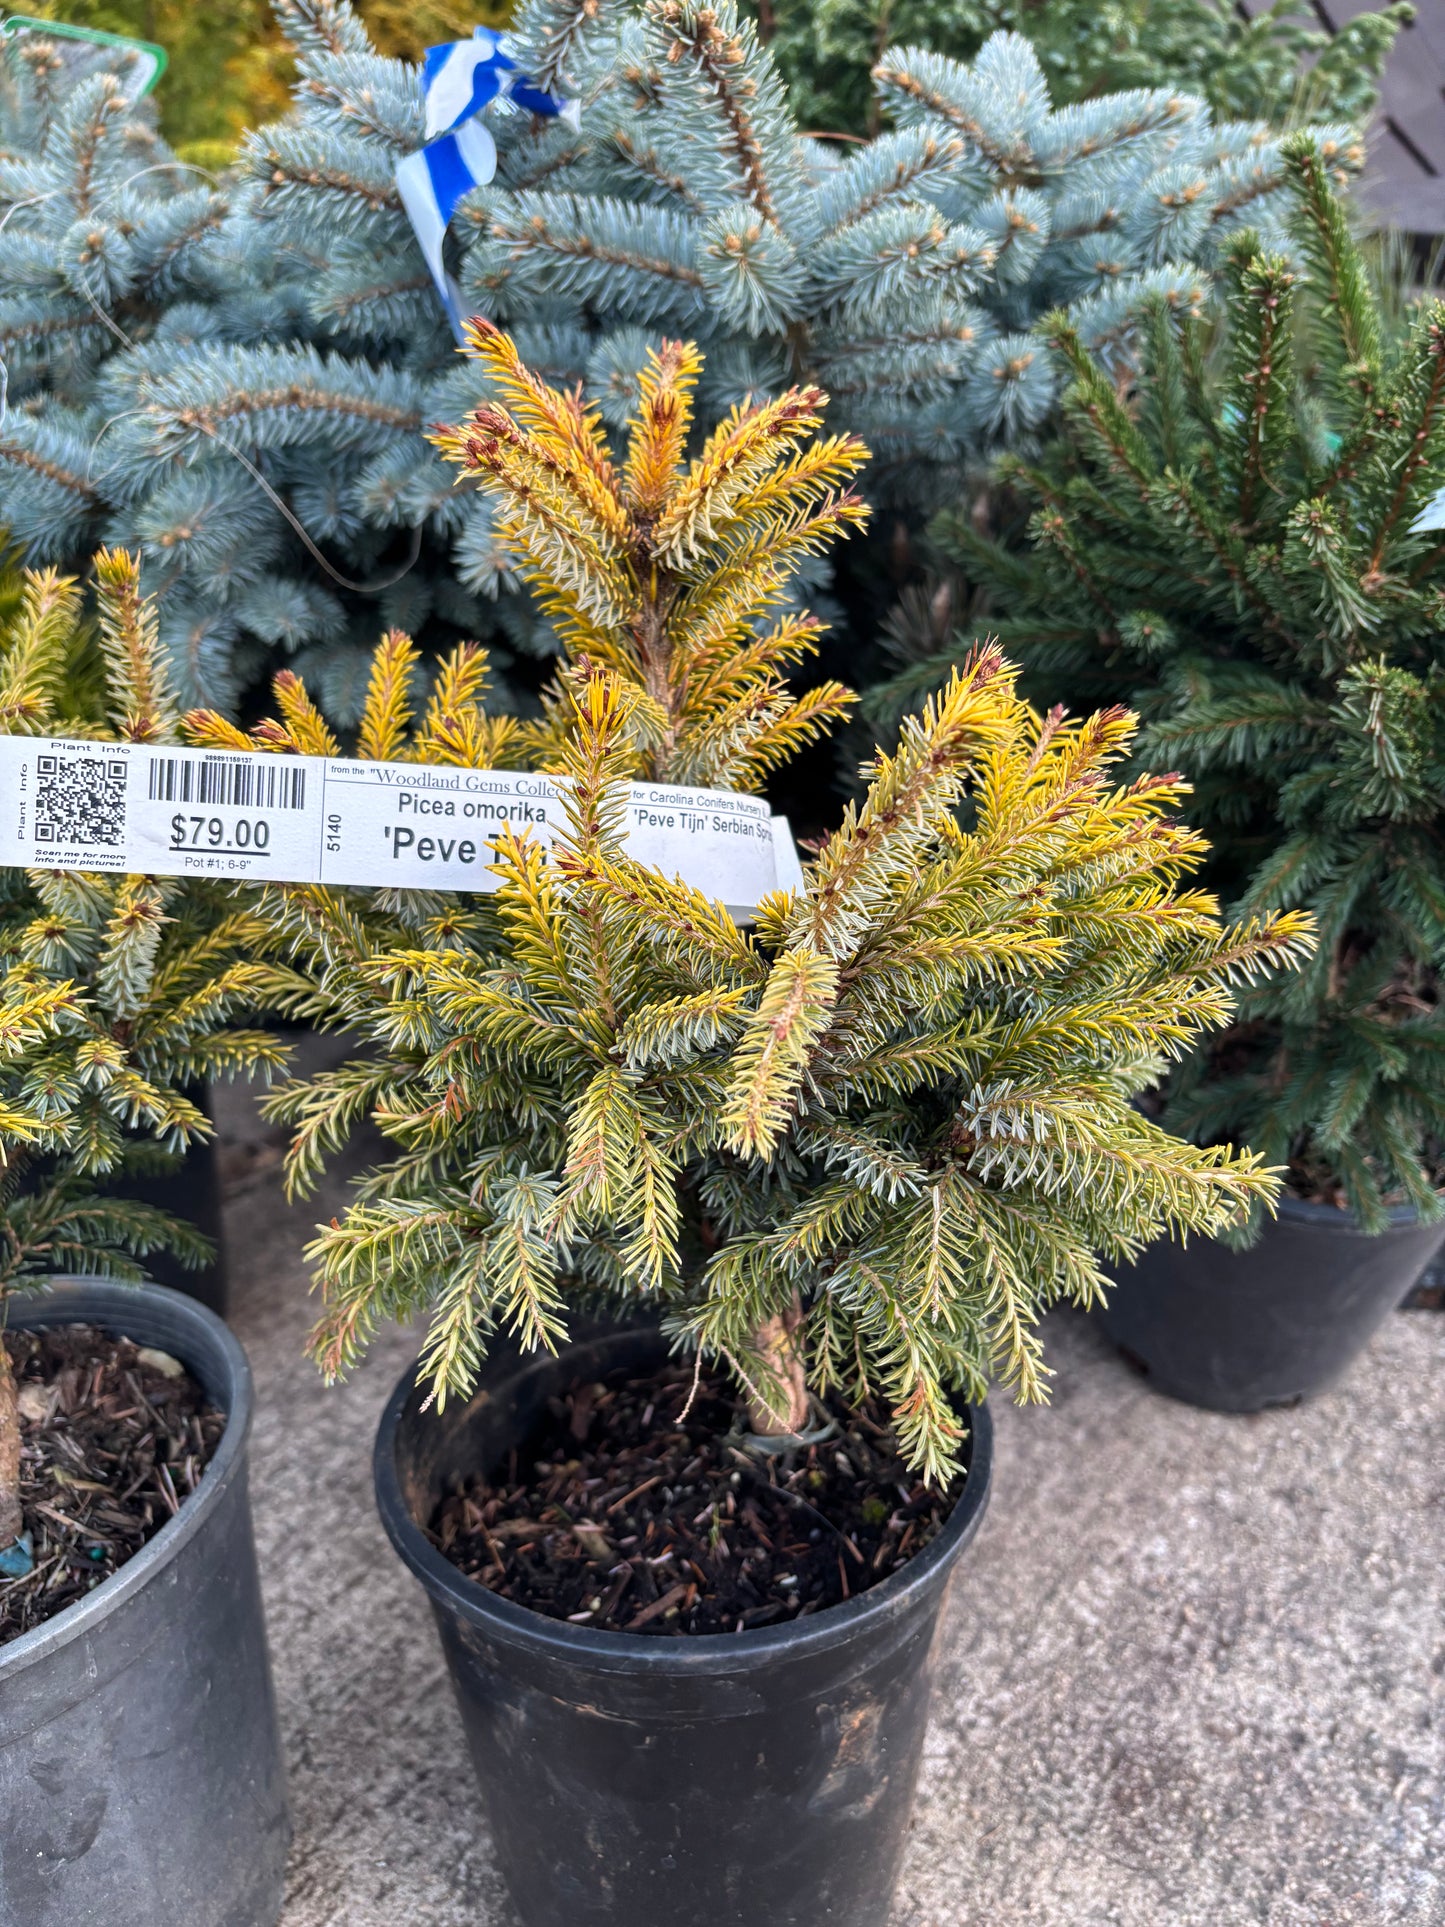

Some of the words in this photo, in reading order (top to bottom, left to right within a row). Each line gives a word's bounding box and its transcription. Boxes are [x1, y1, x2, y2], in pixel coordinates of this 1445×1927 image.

[51, 742, 92, 752] Plant
[102, 746, 131, 754] Info
[20, 763, 28, 791] Info
[331, 766, 350, 774] from
[352, 767, 365, 775] the
[370, 768, 460, 790] "Woodland
[466, 776, 511, 793] Gems
[398, 792, 456, 816] Picea
[463, 801, 547, 823] omorika
[632, 790, 646, 799] for
[649, 791, 694, 806] Carolina
[696, 796, 735, 811] Conifers
[18, 801, 27, 840] Plant
[170, 813, 271, 849] $79.00
[327, 814, 342, 852] 5140
[633, 809, 675, 828] 'Peve
[679, 813, 709, 834] Tijn'
[712, 816, 755, 837] Serbian
[35, 849, 61, 857] Scan
[384, 826, 477, 864] 'Peve
[79, 859, 125, 867] pictures!
[185, 857, 204, 869] Pot
[207, 858, 225, 871] #1;
[228, 860, 251, 870] 6-9"
